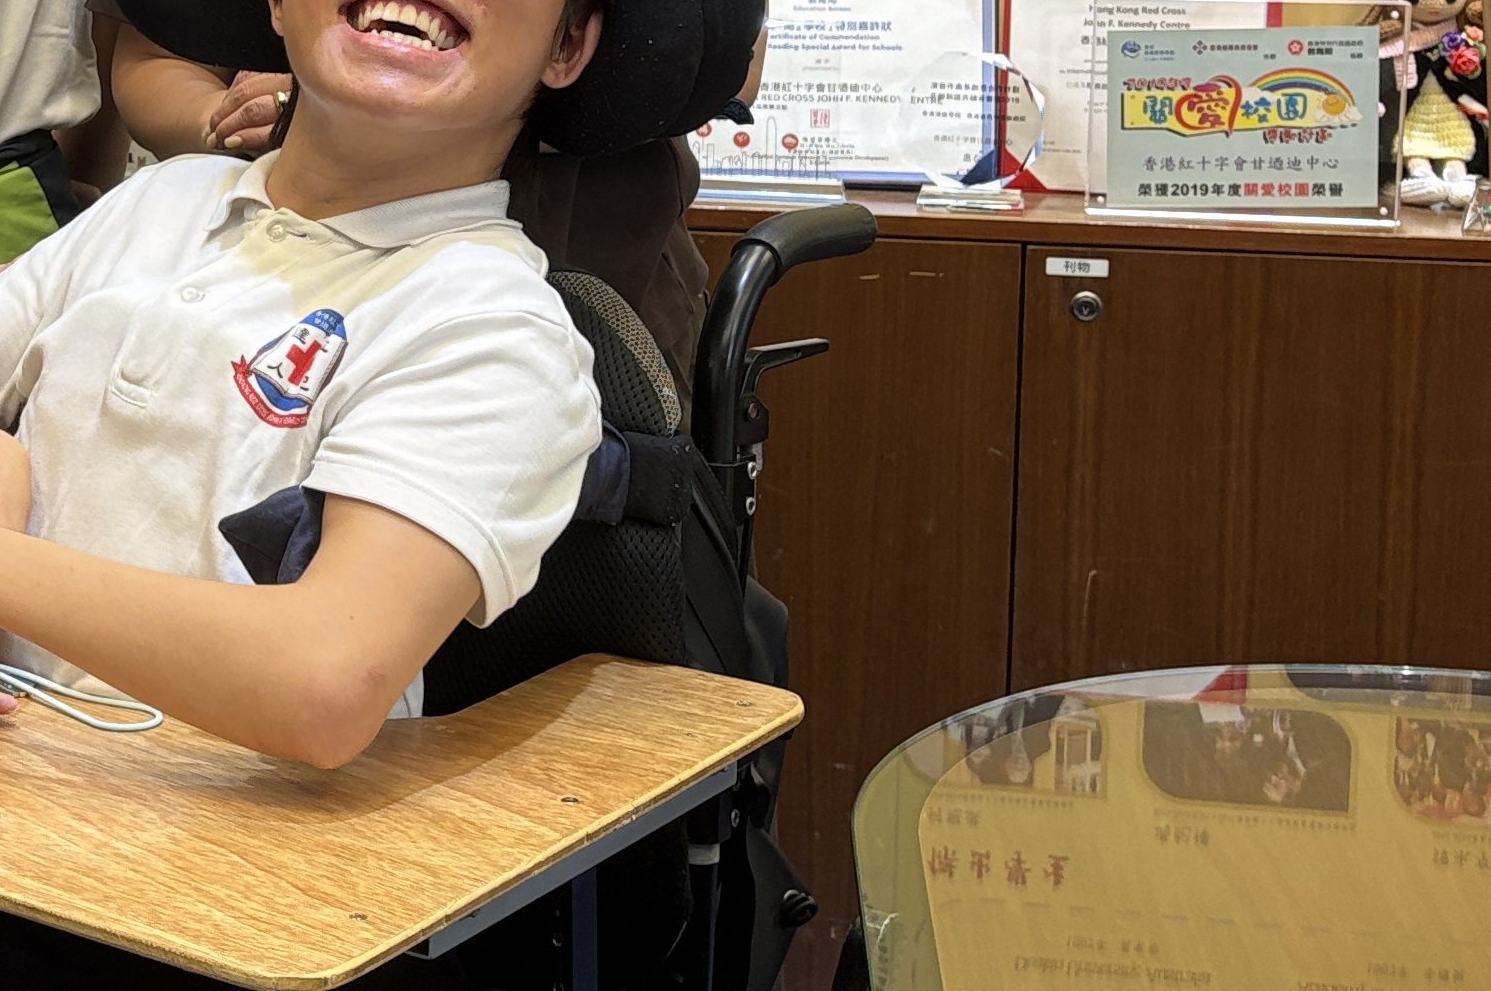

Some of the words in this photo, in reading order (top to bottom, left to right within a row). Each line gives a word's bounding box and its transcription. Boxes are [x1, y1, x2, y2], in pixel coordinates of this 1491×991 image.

[1116, 5, 1139, 16] Kong
[1141, 5, 1160, 15] Red
[1161, 6, 1187, 15] Cross
[1117, 19, 1158, 29] Kennedy
[1159, 20, 1191, 29] Centre
[1137, 182, 1344, 198] 榮獲2019年度關愛校園榮譽
